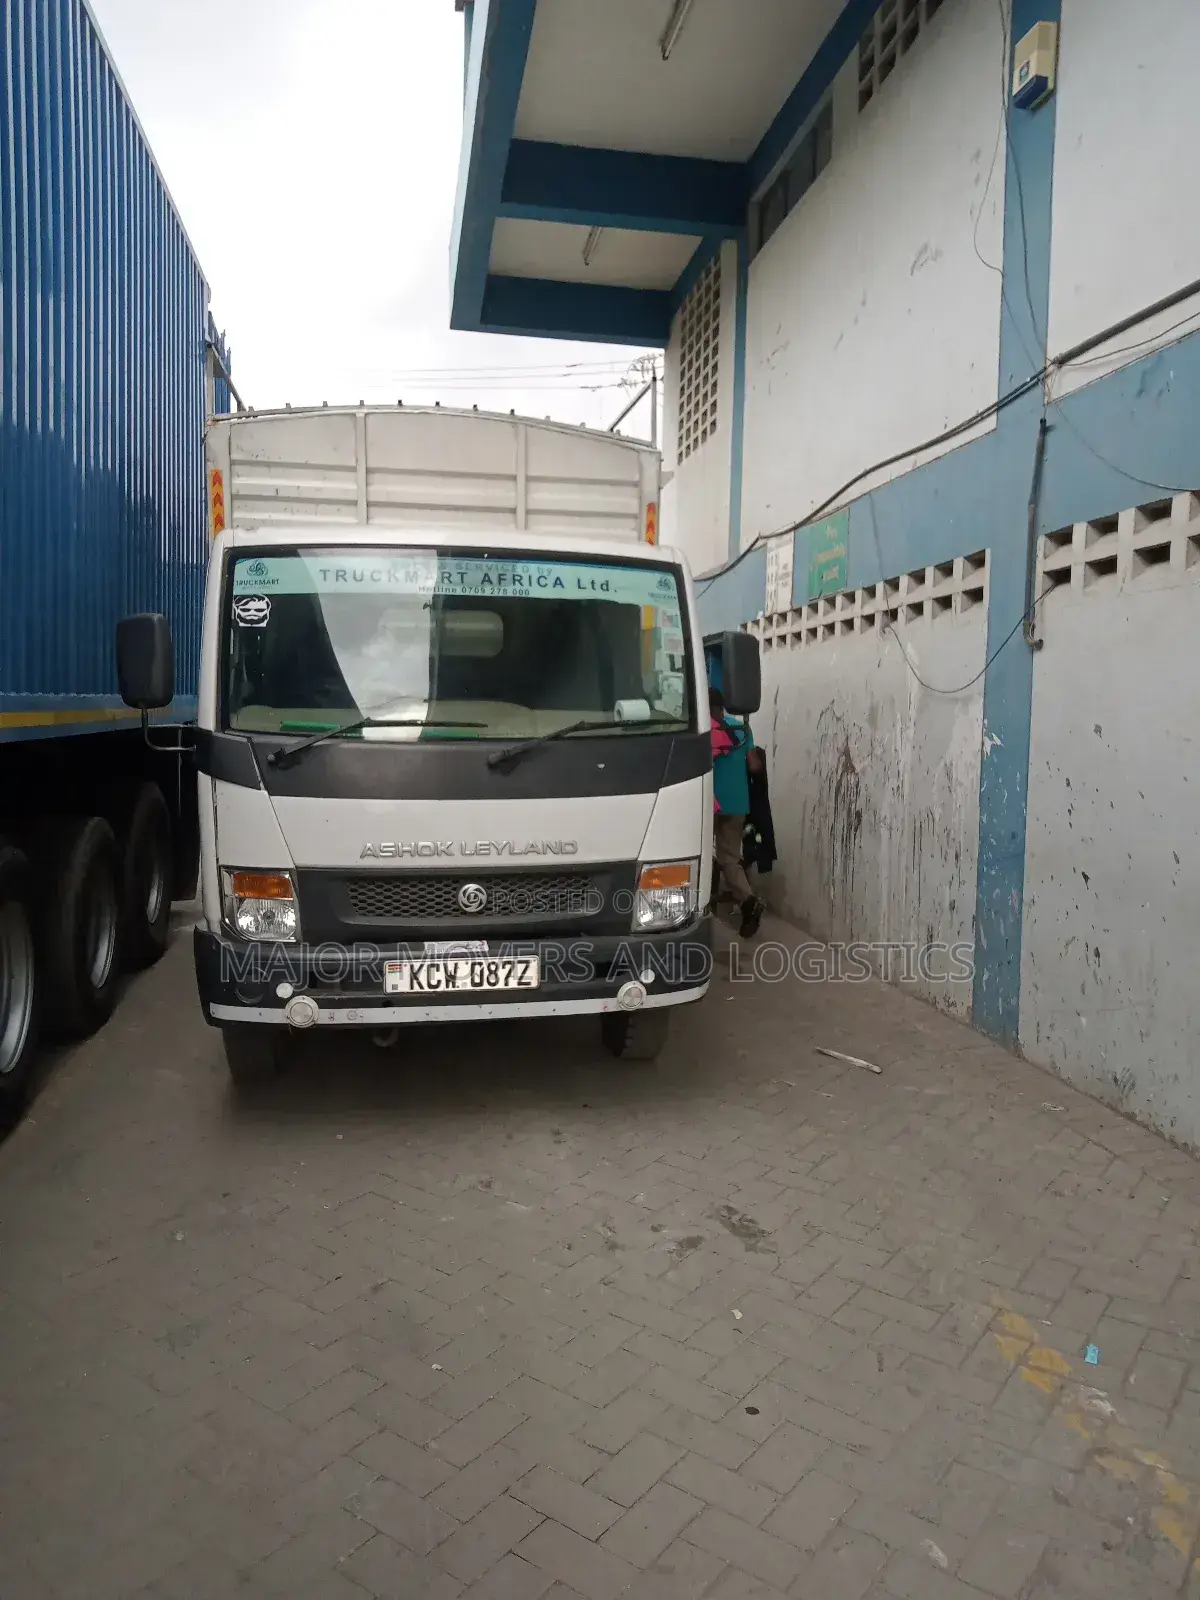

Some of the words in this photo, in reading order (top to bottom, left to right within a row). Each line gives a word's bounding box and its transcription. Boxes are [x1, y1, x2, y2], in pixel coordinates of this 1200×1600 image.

[319, 568, 468, 585] TRUCKMART
[481, 572, 565, 589] AFRICA
[577, 577, 618, 593] Ltd.
[461, 586, 486, 595] 0709
[359, 841, 455, 859] ASHOK
[460, 839, 579, 856] LEYLAND
[409, 962, 459, 990] KCW
[470, 959, 532, 988] 087Z
